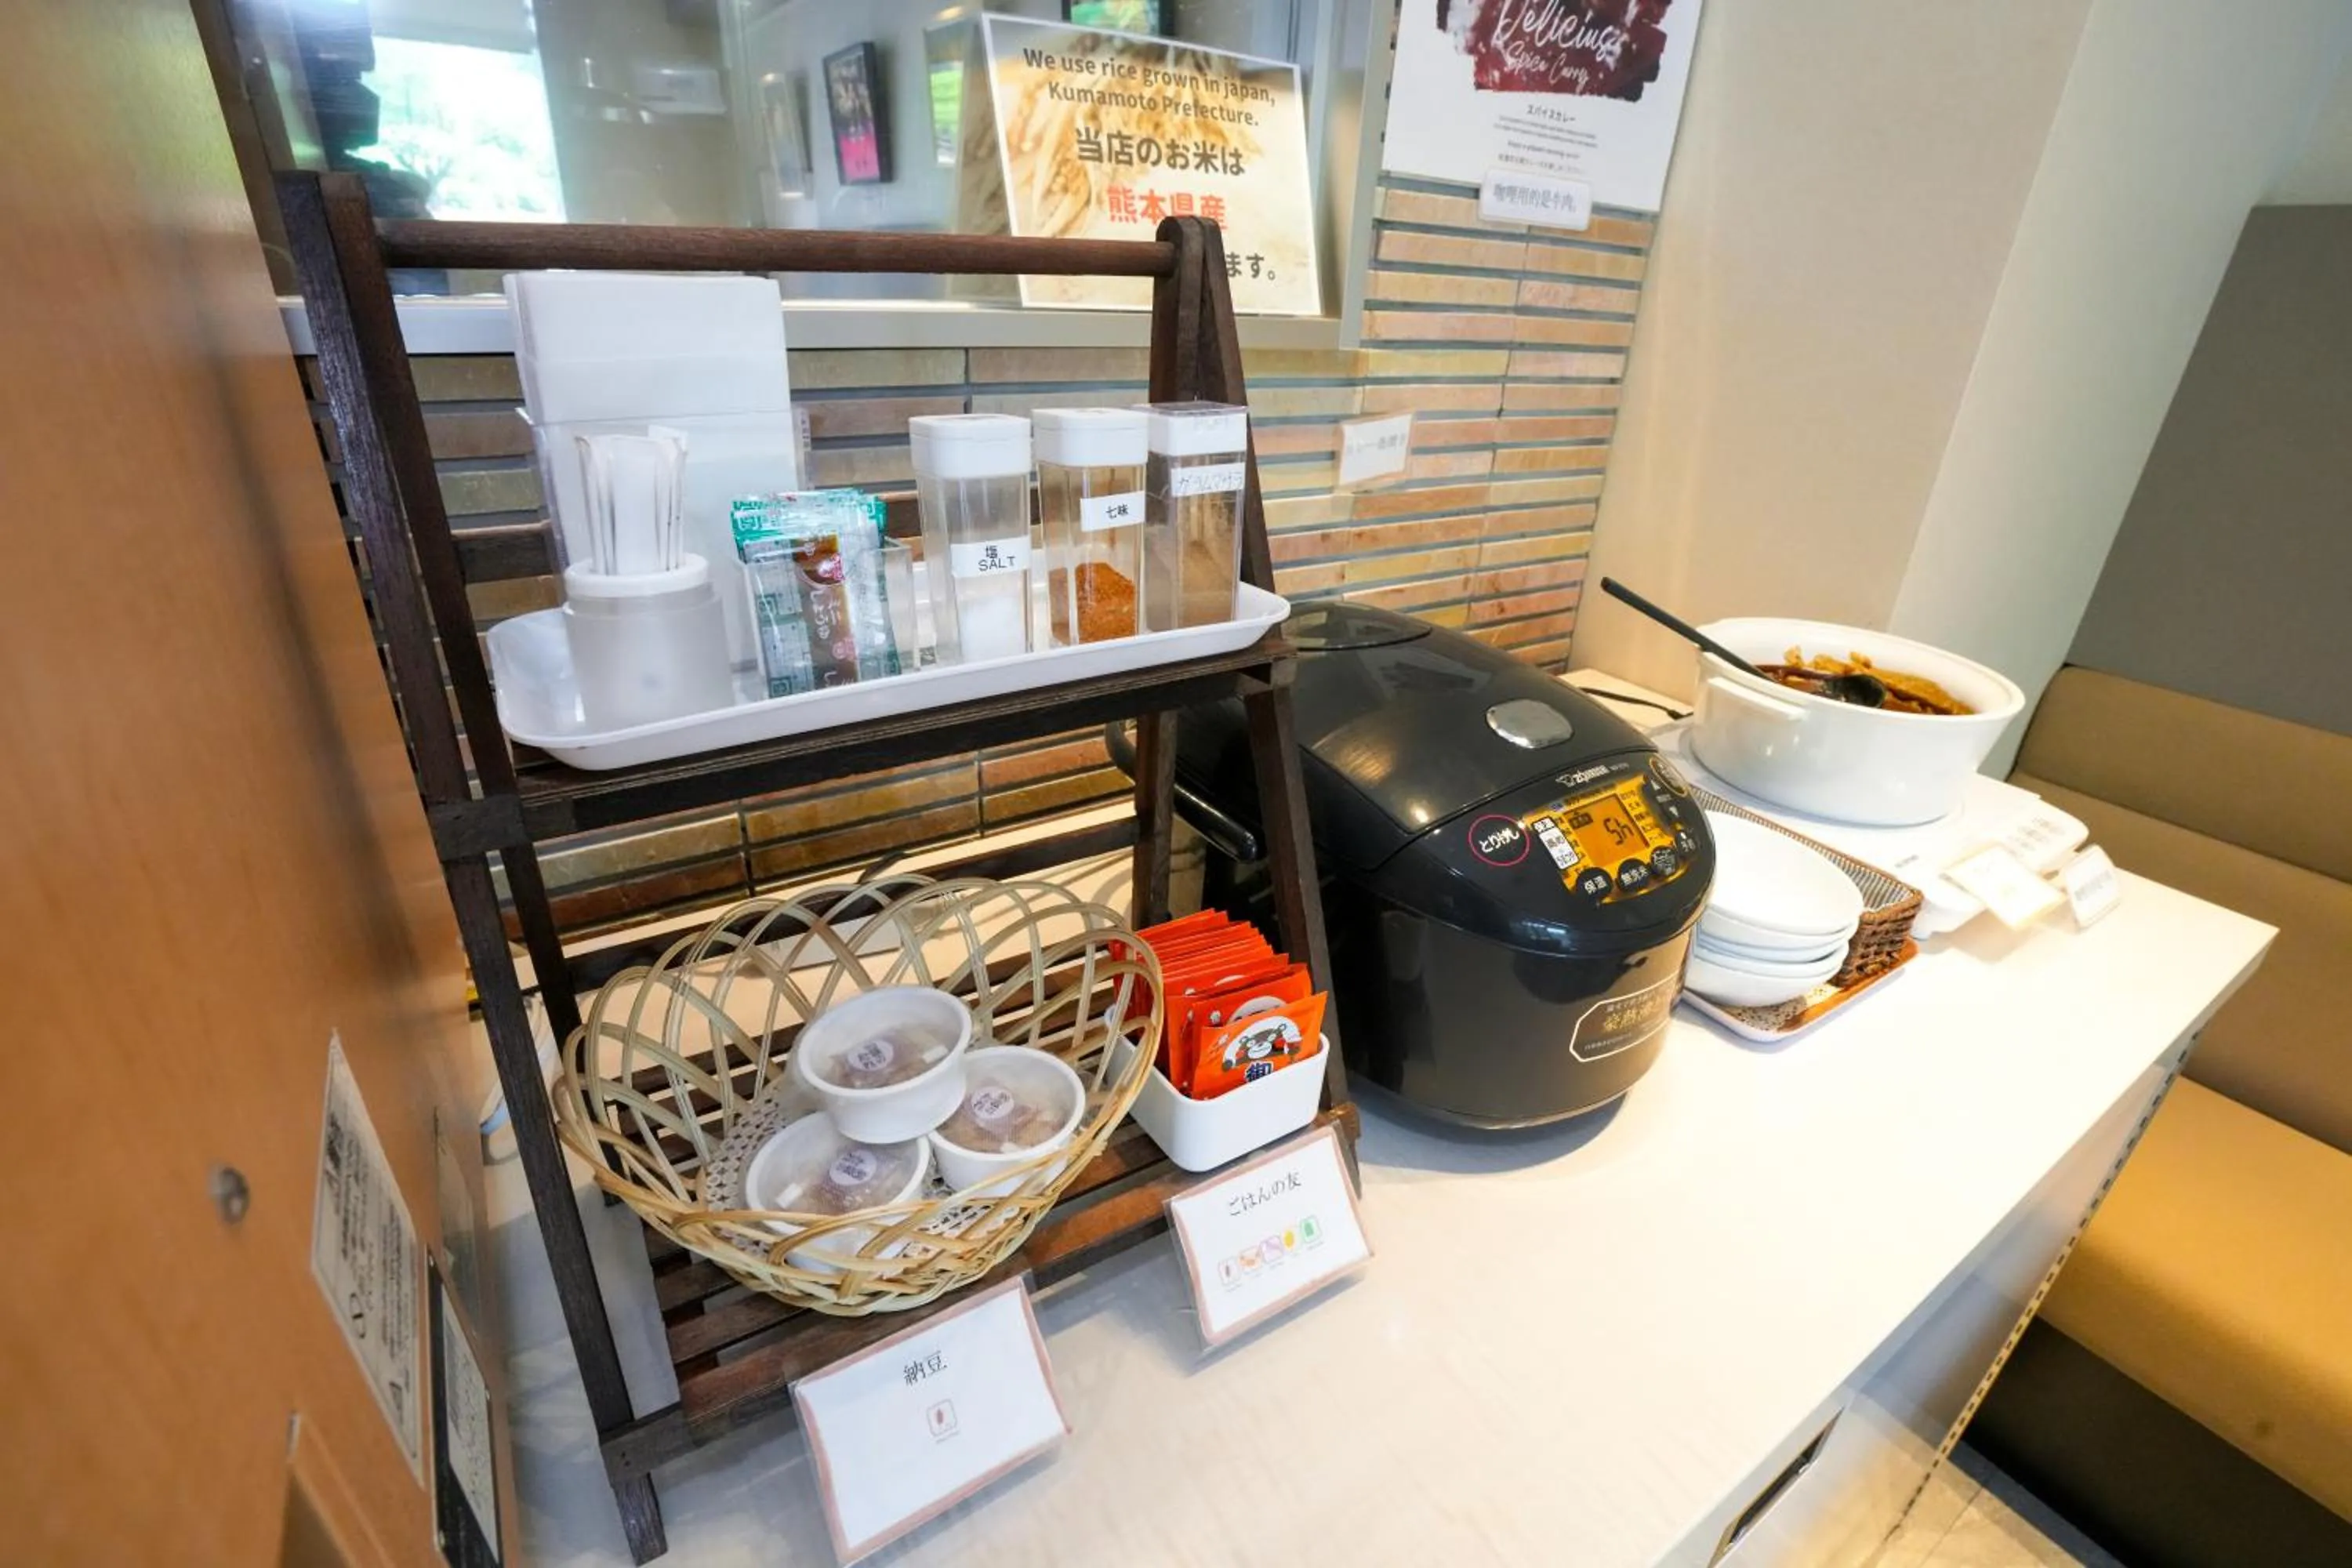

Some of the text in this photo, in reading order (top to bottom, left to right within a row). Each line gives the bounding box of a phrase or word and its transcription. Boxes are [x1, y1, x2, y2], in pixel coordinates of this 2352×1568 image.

[1023, 48, 1276, 106] We use rice grown in japan,
[1048, 82, 1260, 126] Kumamoto Prefecture.
[1075, 127, 1246, 176] 当店のお米は
[1105, 504, 1129, 519] 七味
[978, 556, 1016, 572] SALT
[985, 545, 998, 559] 塩
[1478, 826, 1520, 854] とりけし
[1227, 1171, 1302, 1216] ごはんの友
[902, 1350, 948, 1385] 納豆
